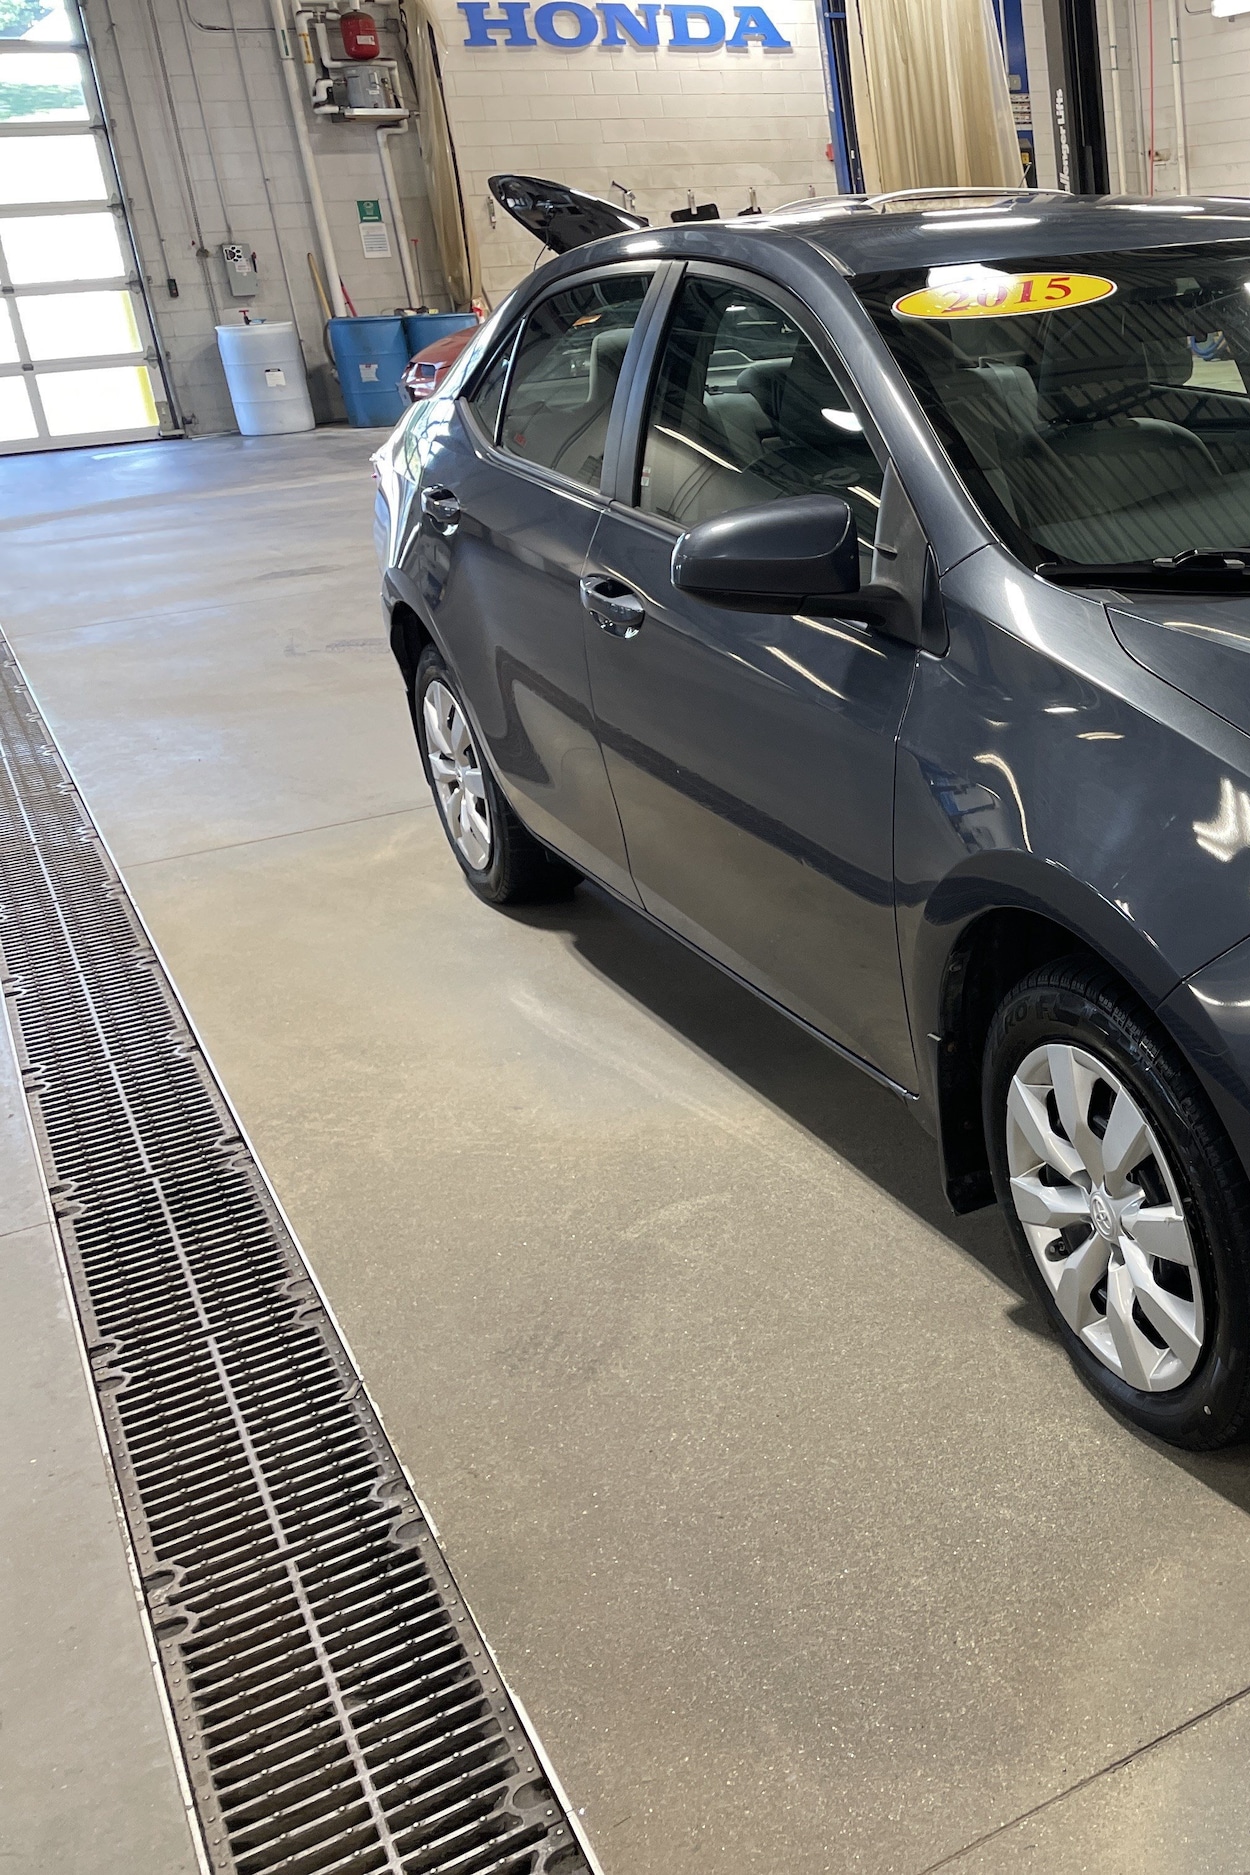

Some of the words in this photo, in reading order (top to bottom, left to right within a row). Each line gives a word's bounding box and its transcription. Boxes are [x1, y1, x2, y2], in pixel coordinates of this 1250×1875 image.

[457, 2, 791, 48] HONDA
[1056, 88, 1065, 125] Lifts
[941, 276, 1072, 314] 2015
